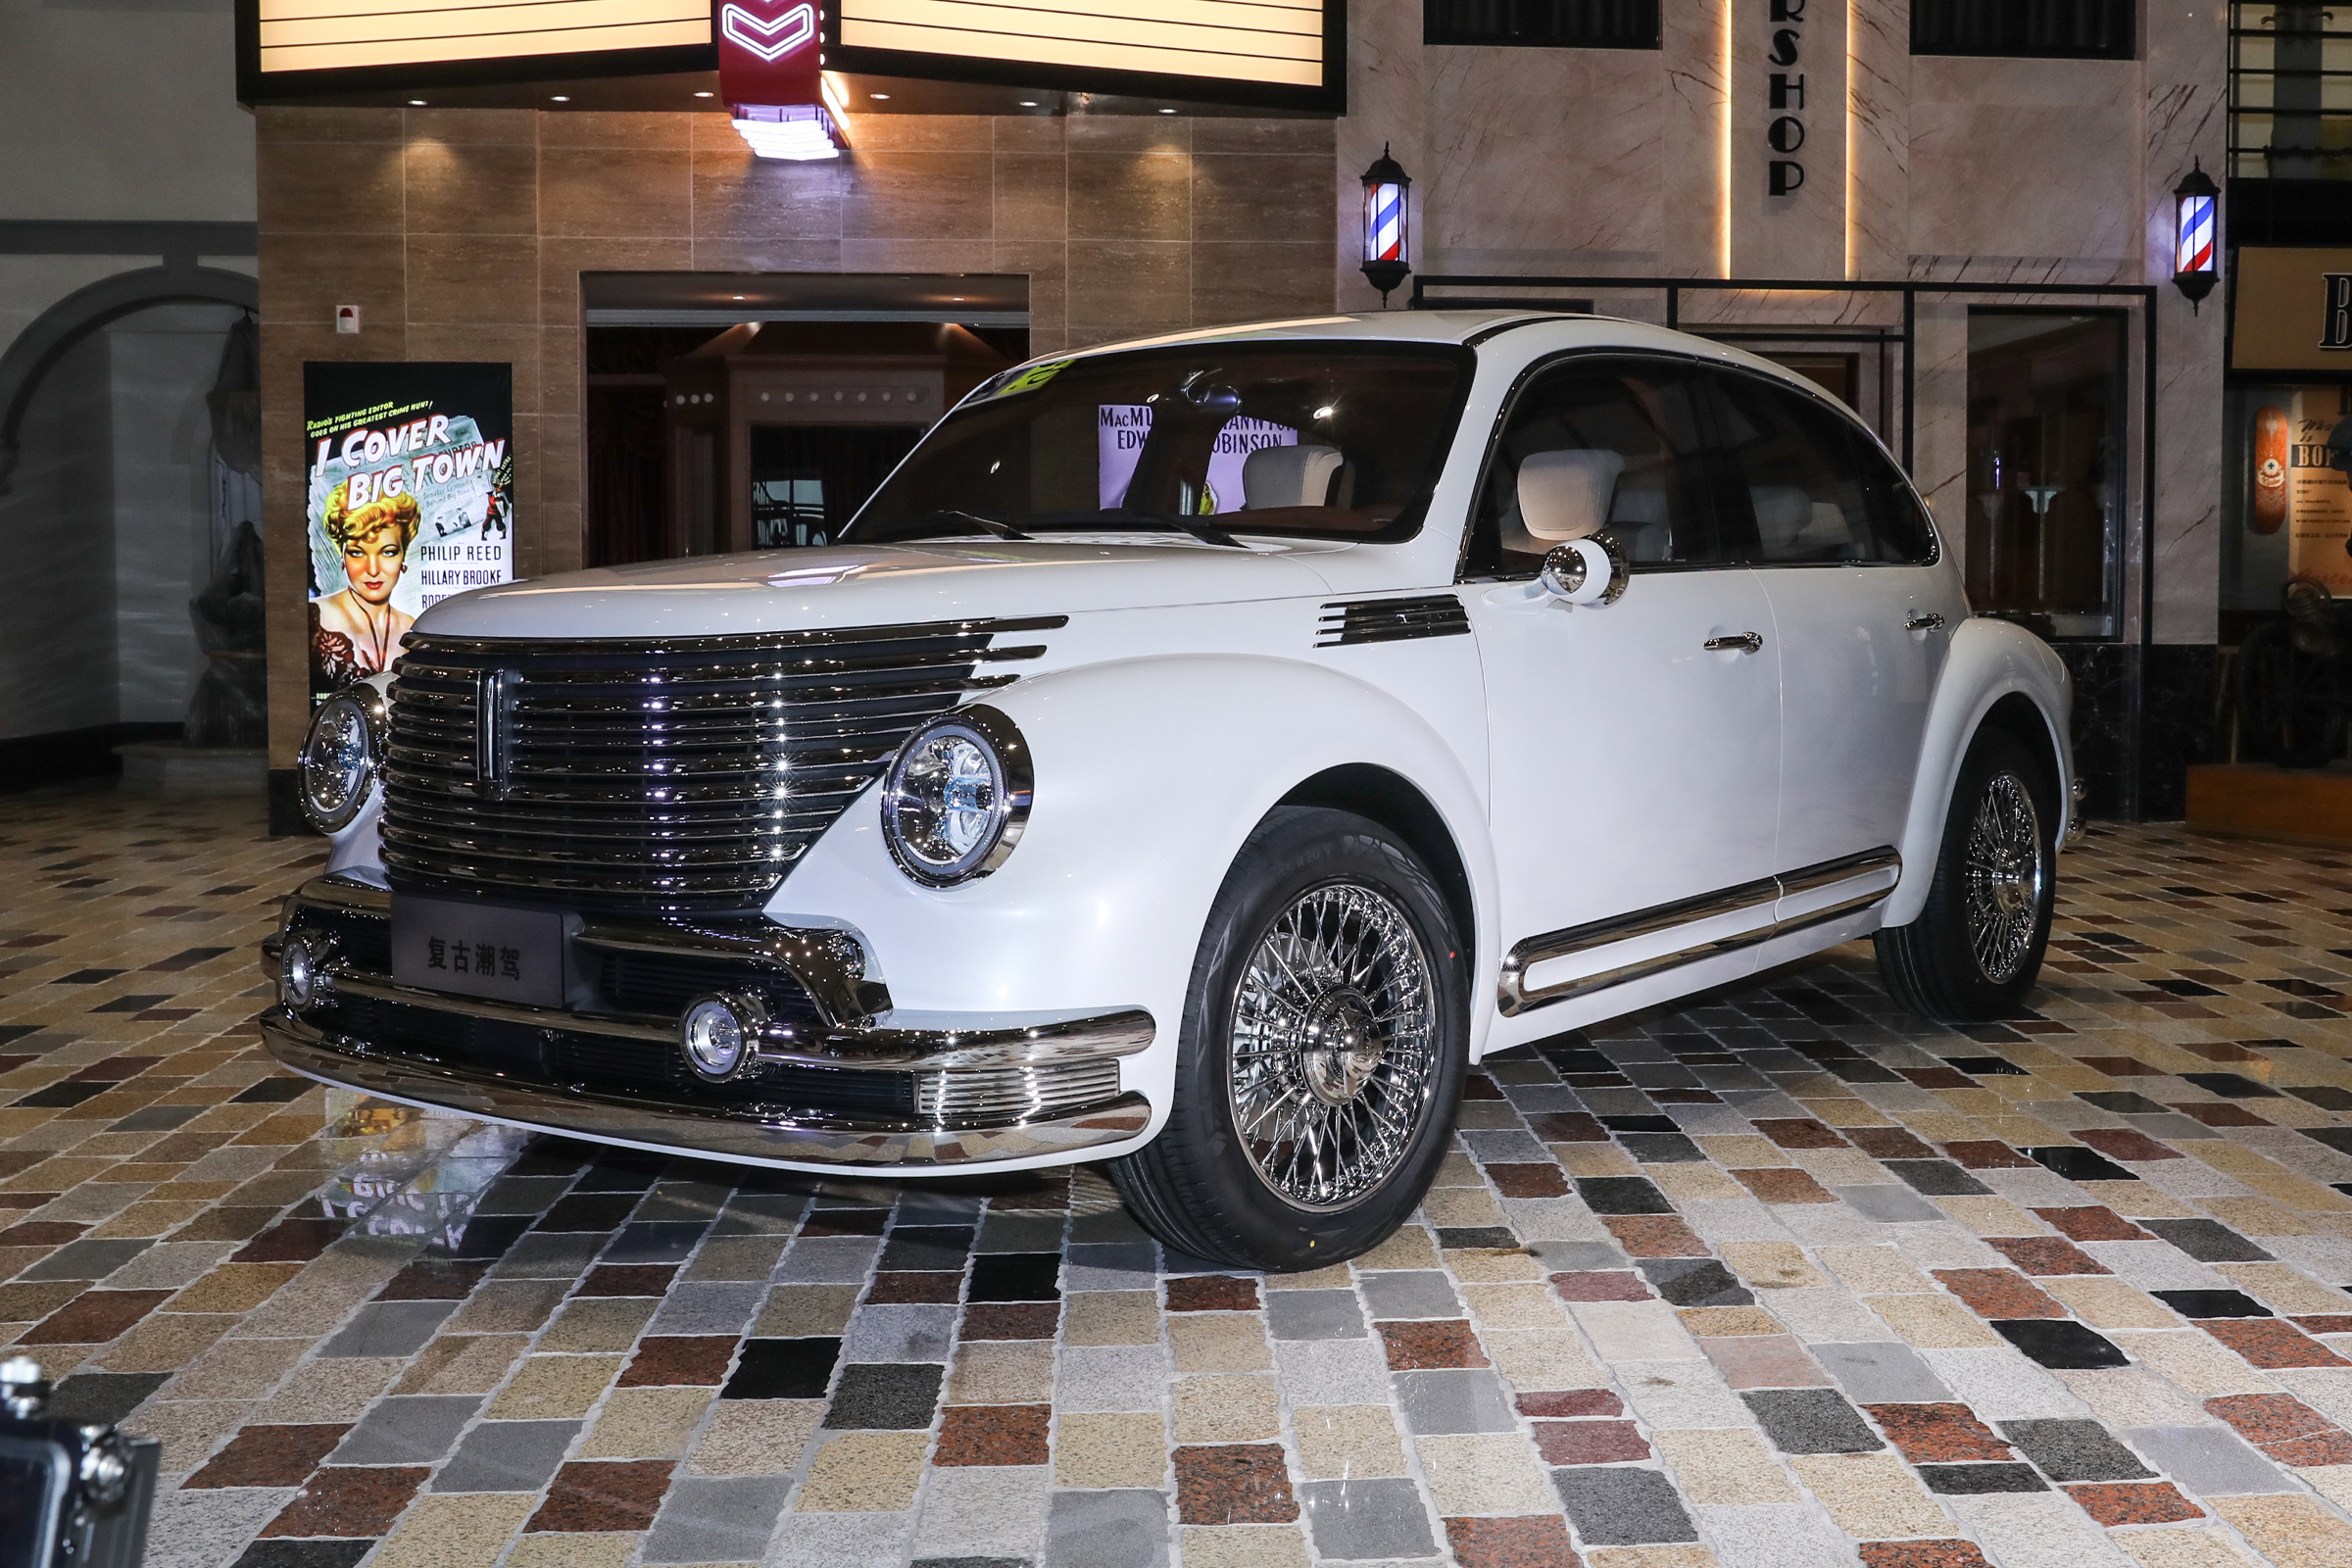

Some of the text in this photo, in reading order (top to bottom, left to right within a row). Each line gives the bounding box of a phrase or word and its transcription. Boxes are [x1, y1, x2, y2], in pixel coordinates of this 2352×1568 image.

[307, 401, 394, 430] RADIO'S FIGHTING EDITOR
[310, 428, 328, 438] GOES
[329, 424, 339, 433] ON
[353, 411, 388, 427] GREATEST
[388, 405, 411, 417] CRIME
[315, 413, 452, 477] I COVER
[1212, 432, 1282, 454] OBINSON
[347, 437, 506, 511] BIG TOWN
[420, 545, 502, 562] PHILIP REED
[420, 569, 462, 585] HILLARY
[427, 936, 520, 981] 复古潮驾
